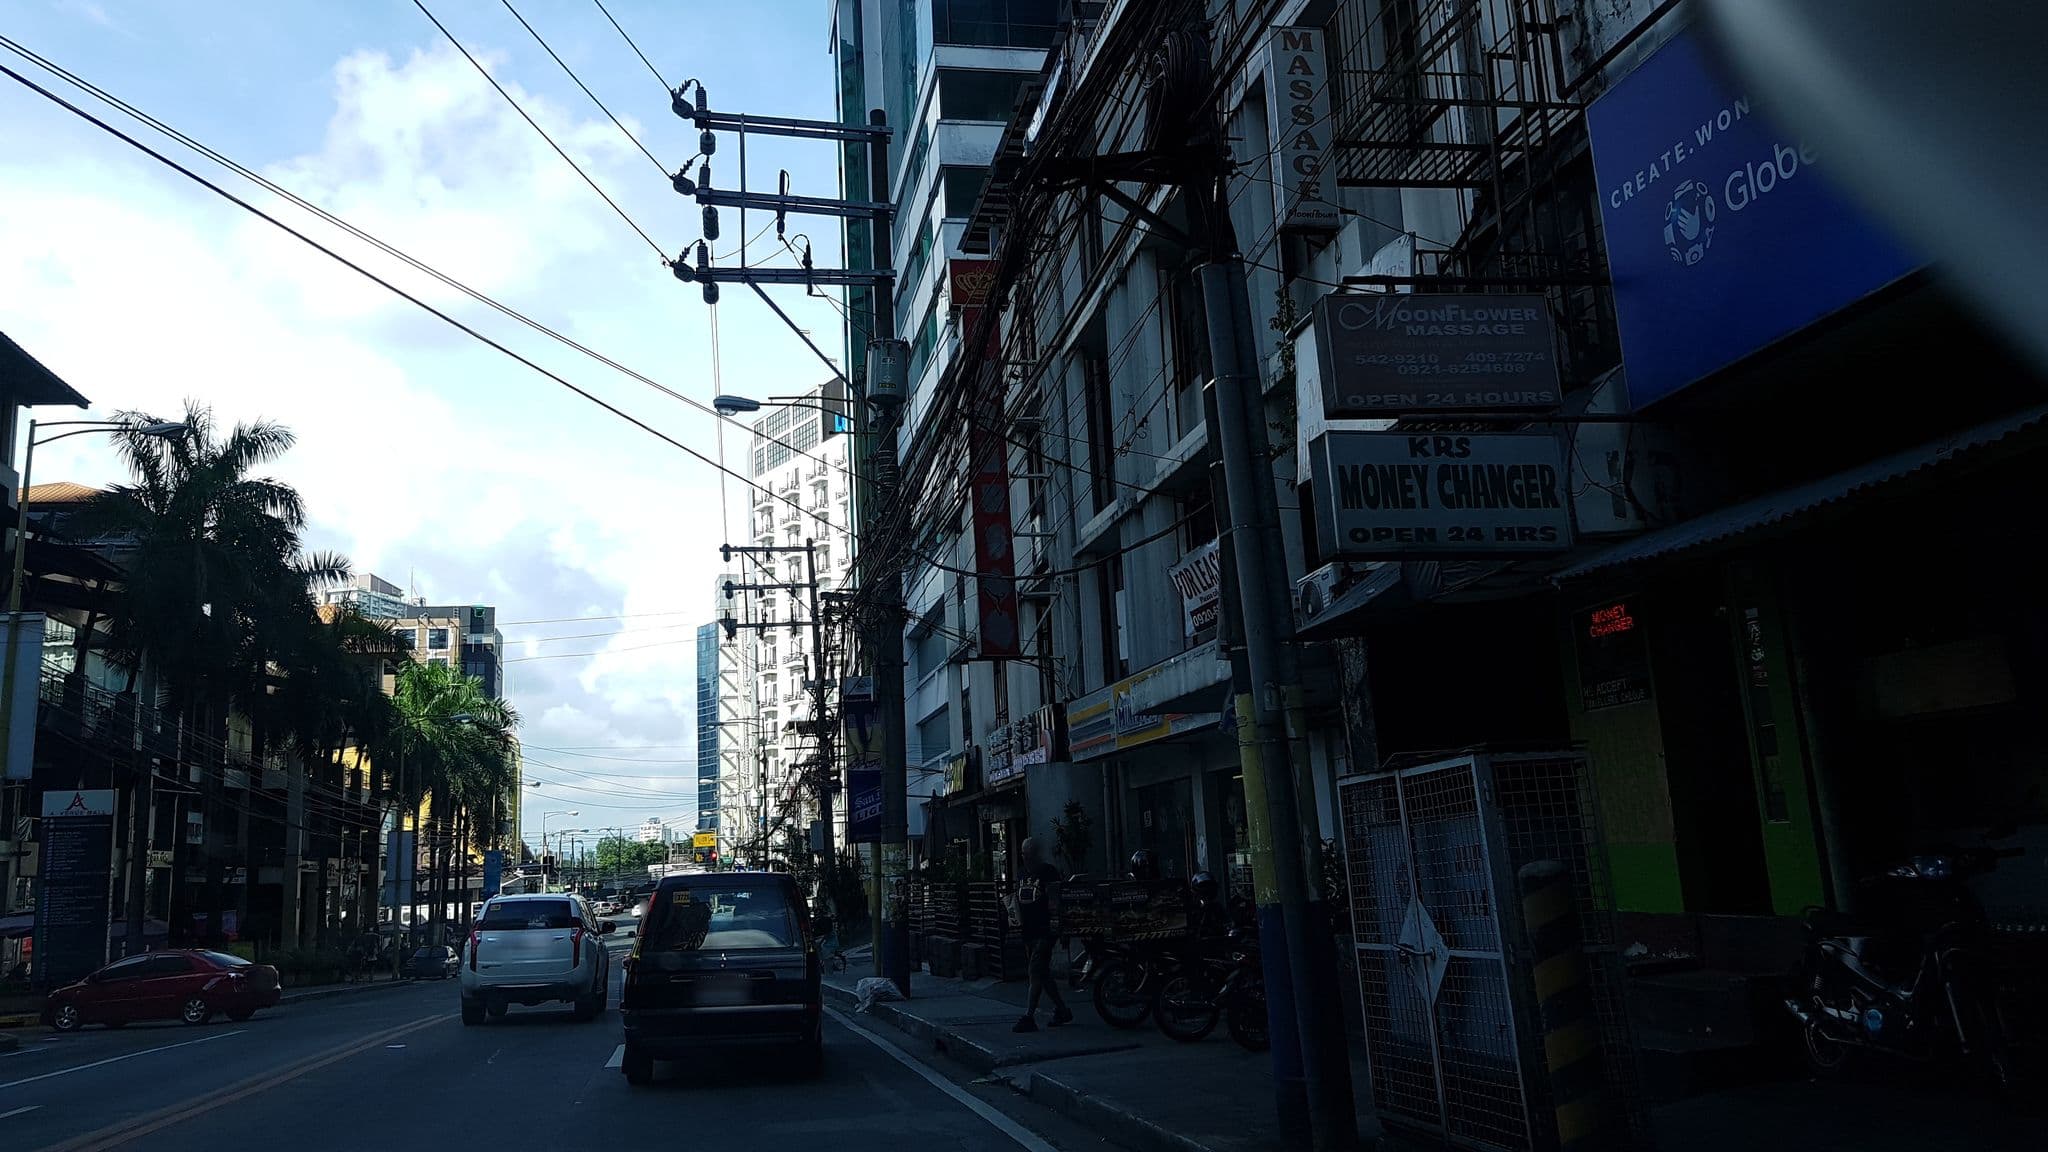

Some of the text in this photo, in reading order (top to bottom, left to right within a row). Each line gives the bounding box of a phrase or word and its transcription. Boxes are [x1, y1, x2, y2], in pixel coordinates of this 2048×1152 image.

[1281, 31, 1321, 202] MASSAGE
[1725, 143, 1818, 211] Globe
[1406, 324, 1528, 336] MASSAGE
[1347, 391, 1553, 408] OPEN 24 HOURS
[1408, 436, 1471, 459] KRS
[1338, 464, 1560, 510] MONEY CHANGER
[1349, 526, 1558, 543] OPEN 24 HRS
[1591, 604, 1625, 624] MONEY
